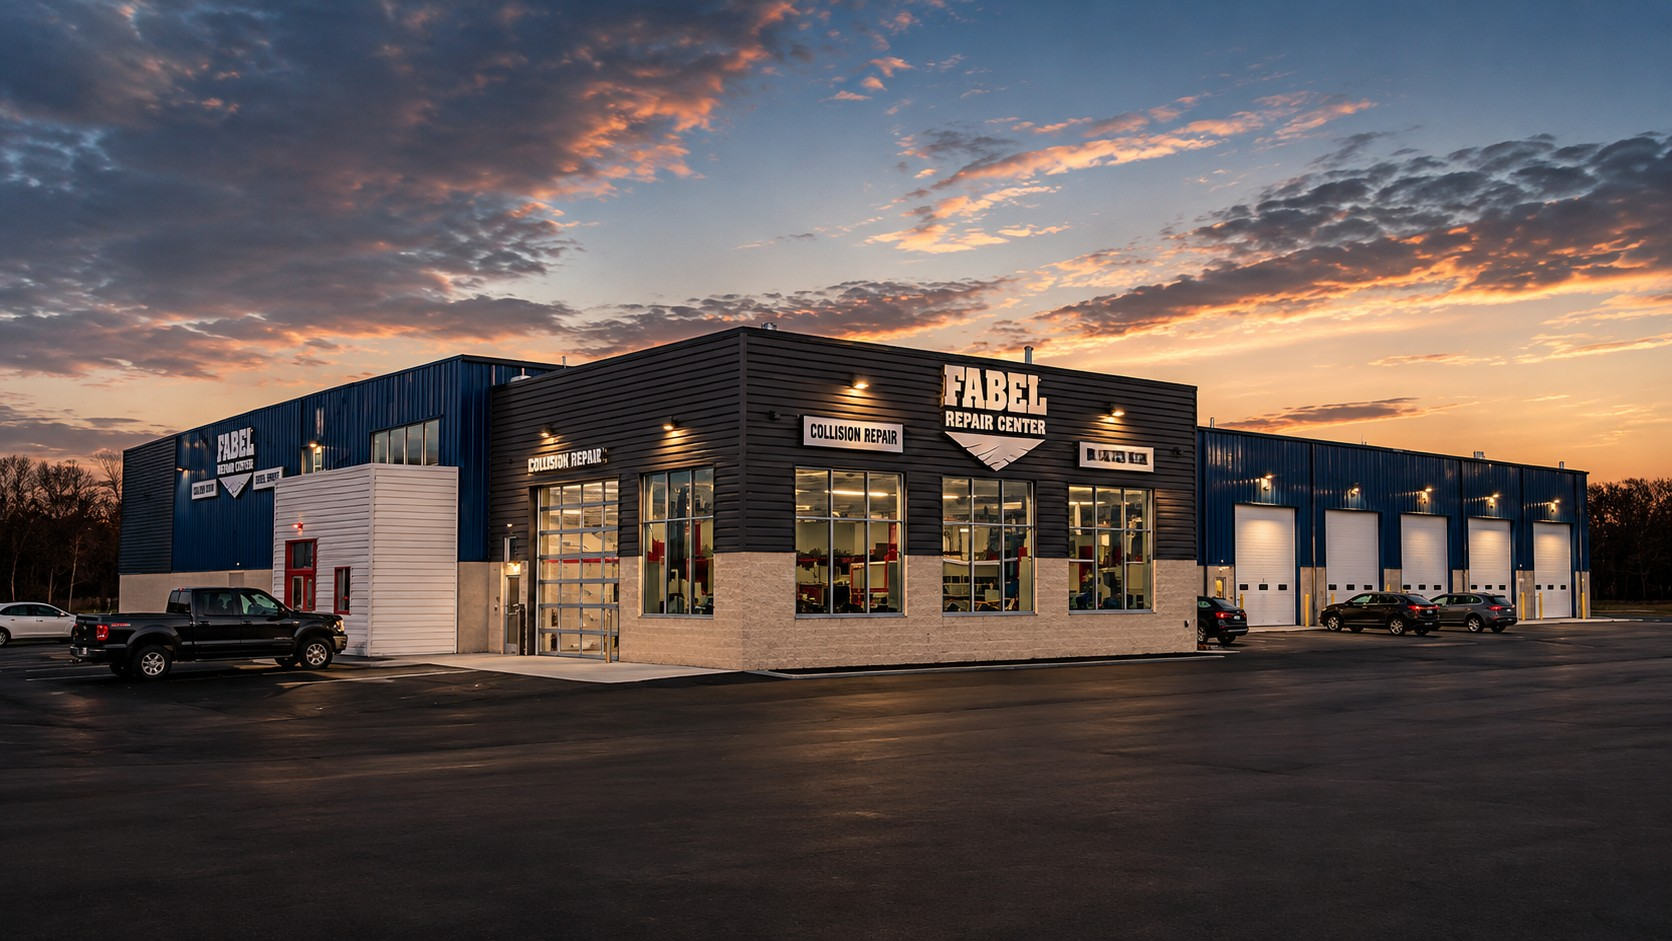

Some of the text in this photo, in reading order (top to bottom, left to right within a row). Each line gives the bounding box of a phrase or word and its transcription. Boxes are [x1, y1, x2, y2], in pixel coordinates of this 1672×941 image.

[944, 364, 1047, 416] FABEL
[810, 423, 898, 445] COLLISION REPAIR
[945, 410, 1046, 435] REPAIR CENTER
[217, 427, 254, 462] FABEL
[528, 448, 602, 473] COLLISION REPAIR
